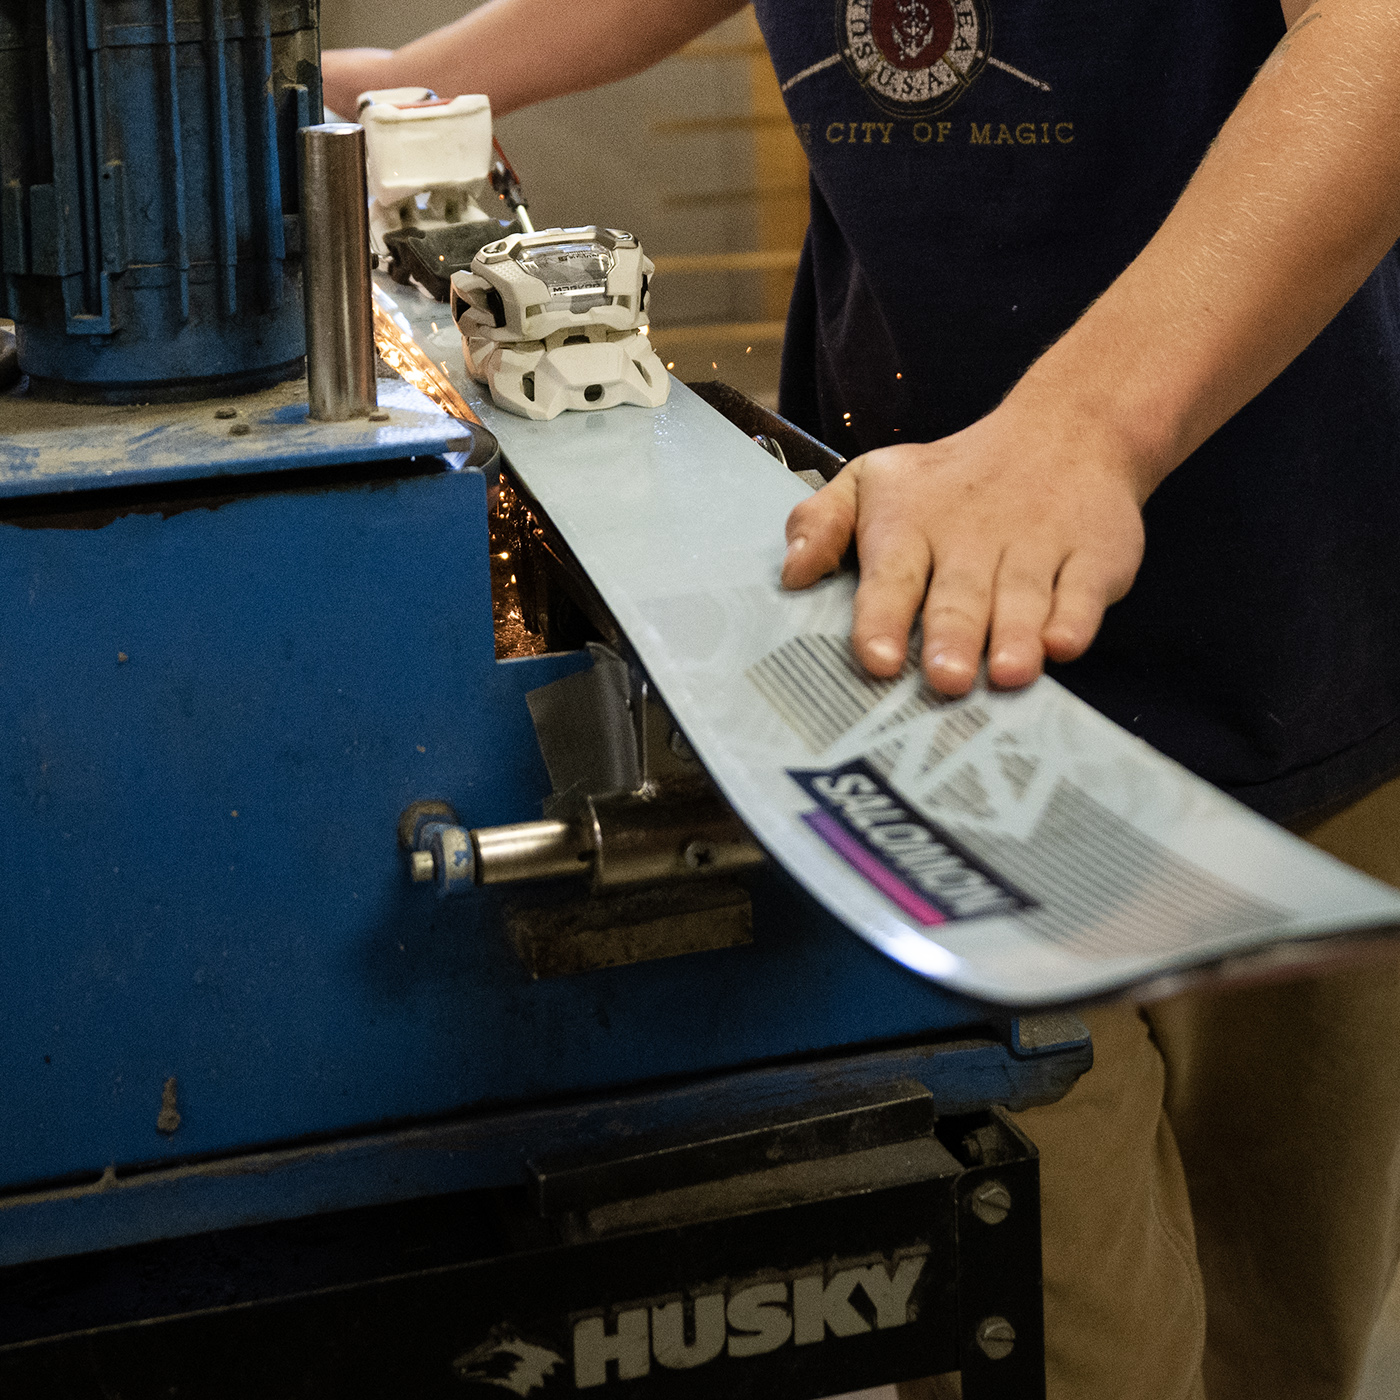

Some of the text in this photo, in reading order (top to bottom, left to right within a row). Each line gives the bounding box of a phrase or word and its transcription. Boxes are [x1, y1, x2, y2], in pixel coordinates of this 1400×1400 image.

[825, 121, 895, 145] CITY
[912, 121, 952, 145] OF
[969, 120, 1075, 146] MAGIC
[811, 772, 1004, 917] SALOMON
[573, 1255, 928, 1389] HUSKY
